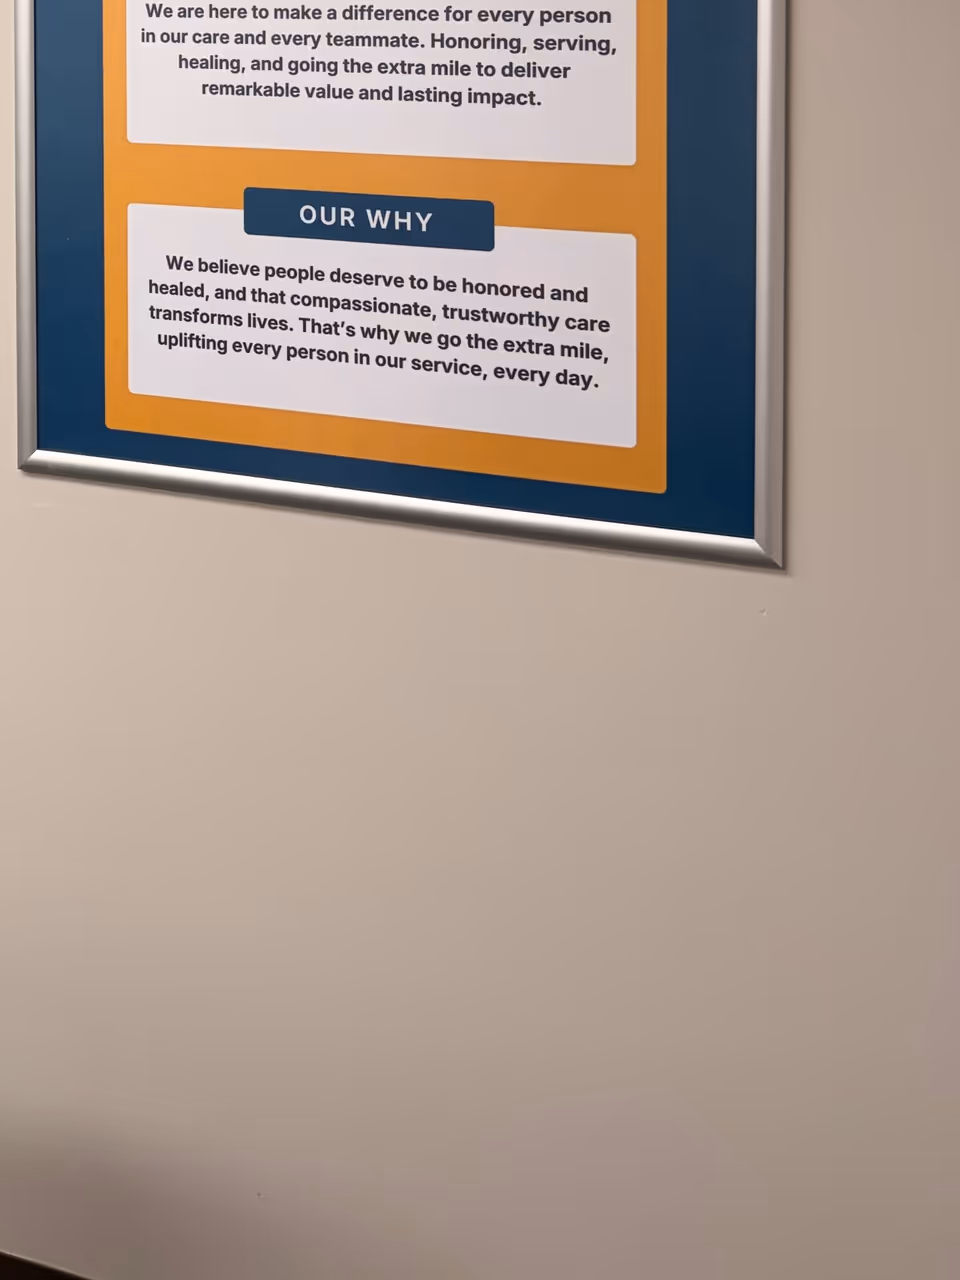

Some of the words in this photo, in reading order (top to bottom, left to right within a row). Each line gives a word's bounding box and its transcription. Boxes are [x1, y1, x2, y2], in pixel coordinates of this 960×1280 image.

[145, 3, 173, 18] We
[177, 7, 204, 18] are
[208, 3, 248, 19] here
[251, 5, 269, 19] to
[274, 4, 322, 20] make
[326, 8, 337, 20] a
[342, 4, 439, 21] difference
[443, 5, 472, 22] for
[477, 9, 534, 26] every
[539, 10, 612, 26] person
[141, 28, 156, 43] in
[160, 32, 188, 43] our
[192, 32, 230, 44] care
[234, 30, 266, 45] and
[270, 33, 321, 49] every
[325, 32, 425, 48] teammate.
[430, 33, 527, 54] Honoring,
[532, 35, 616, 55] serving,
[178, 54, 245, 74] healing,
[250, 56, 283, 71] and
[287, 57, 338, 76] going
[342, 58, 373, 73] the
[377, 60, 426, 75] extra
[431, 59, 471, 76] mile
[475, 61, 496, 77] to
[500, 61, 571, 78] deliver
[202, 82, 300, 97] remarkable
[304, 84, 354, 99] value
[358, 85, 393, 101] and
[398, 86, 462, 107] lasting
[467, 87, 542, 108] impact.
[299, 205, 355, 226] OUR
[366, 209, 432, 231] WHY
[165, 255, 194, 271] We
[198, 257, 260, 276] believe
[264, 265, 325, 283] people
[329, 268, 404, 288] deserve
[408, 274, 428, 290] to
[433, 275, 457, 292] be
[462, 278, 545, 299] honored
[550, 286, 588, 303] and
[148, 279, 209, 301] healed,
[214, 286, 246, 301] and
[250, 287, 286, 304] that
[290, 294, 436, 320] compassionate,
[441, 305, 560, 332] trustworthy
[564, 317, 610, 332] care
[148, 306, 243, 326] transforms
[247, 312, 294, 331] lives.
[360, 324, 400, 345] why
[404, 330, 432, 344] we
[436, 333, 462, 350] go
[465, 333, 498, 351] the
[503, 339, 554, 356] extra
[560, 342, 608, 364] mile,
[157, 332, 228, 355] uplifting
[232, 341, 282, 360] every
[286, 346, 349, 363] person
[354, 348, 370, 365] in
[374, 355, 406, 368] our
[410, 358, 488, 380] service,
[493, 366, 550, 387] every
[555, 369, 599, 391] day.
